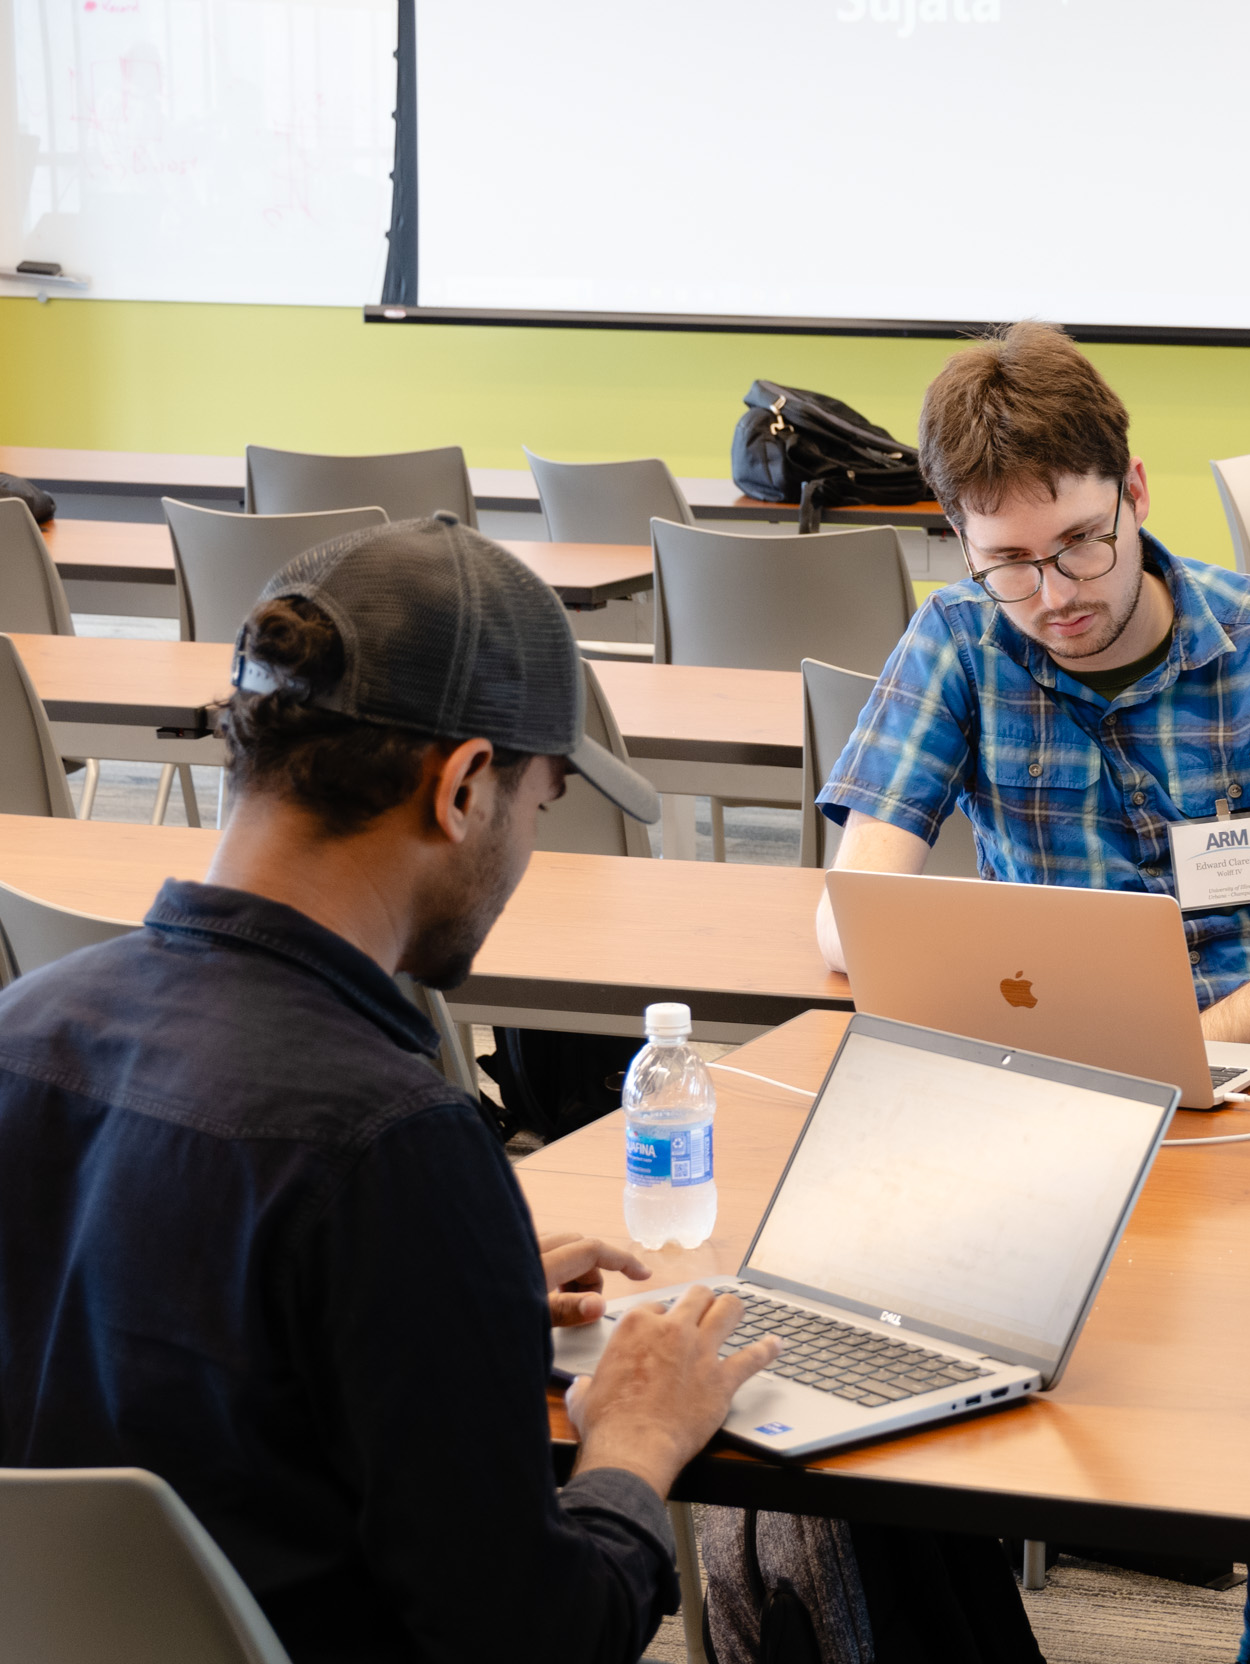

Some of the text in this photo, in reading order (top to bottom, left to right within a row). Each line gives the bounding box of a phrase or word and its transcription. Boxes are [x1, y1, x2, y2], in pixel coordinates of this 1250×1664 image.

[1206, 829, 1249, 850] ARM
[1196, 859, 1227, 870] Edward
[1216, 869, 1235, 877] Wolff
[1208, 886, 1234, 894] University
